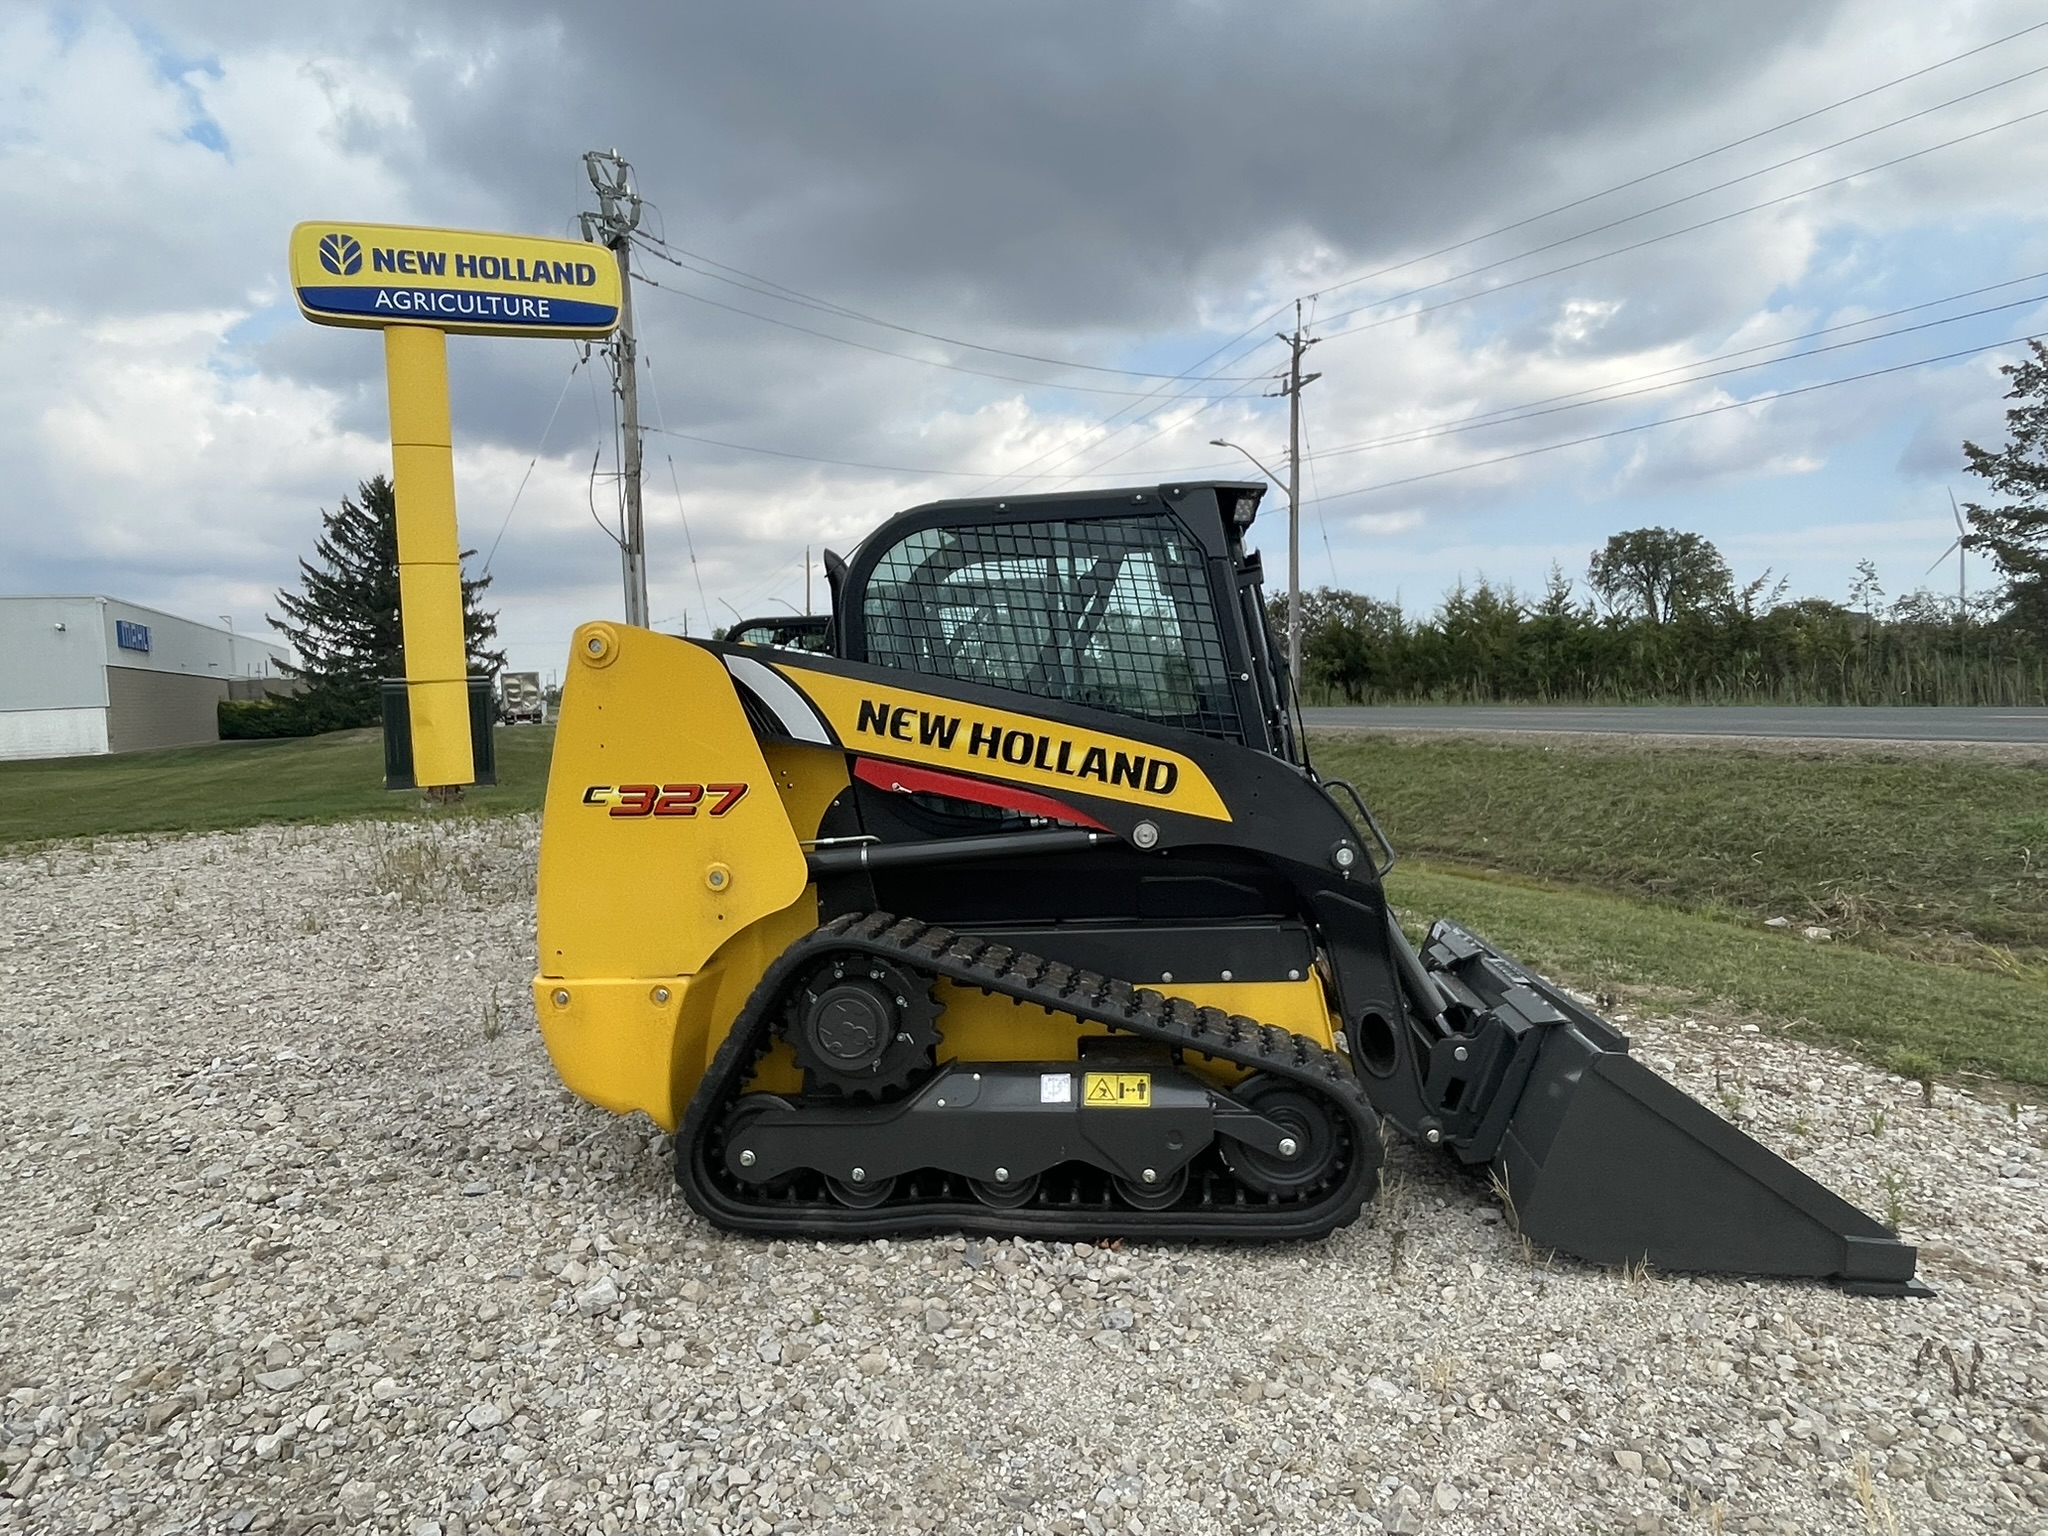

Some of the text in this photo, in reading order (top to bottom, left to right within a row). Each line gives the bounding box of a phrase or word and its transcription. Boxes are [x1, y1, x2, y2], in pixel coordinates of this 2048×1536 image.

[372, 247, 597, 287] NEW HOLLAND
[375, 289, 551, 319] AGRICULTURE
[856, 699, 1179, 796] NEW HOLLAND
[582, 783, 749, 817] C327
